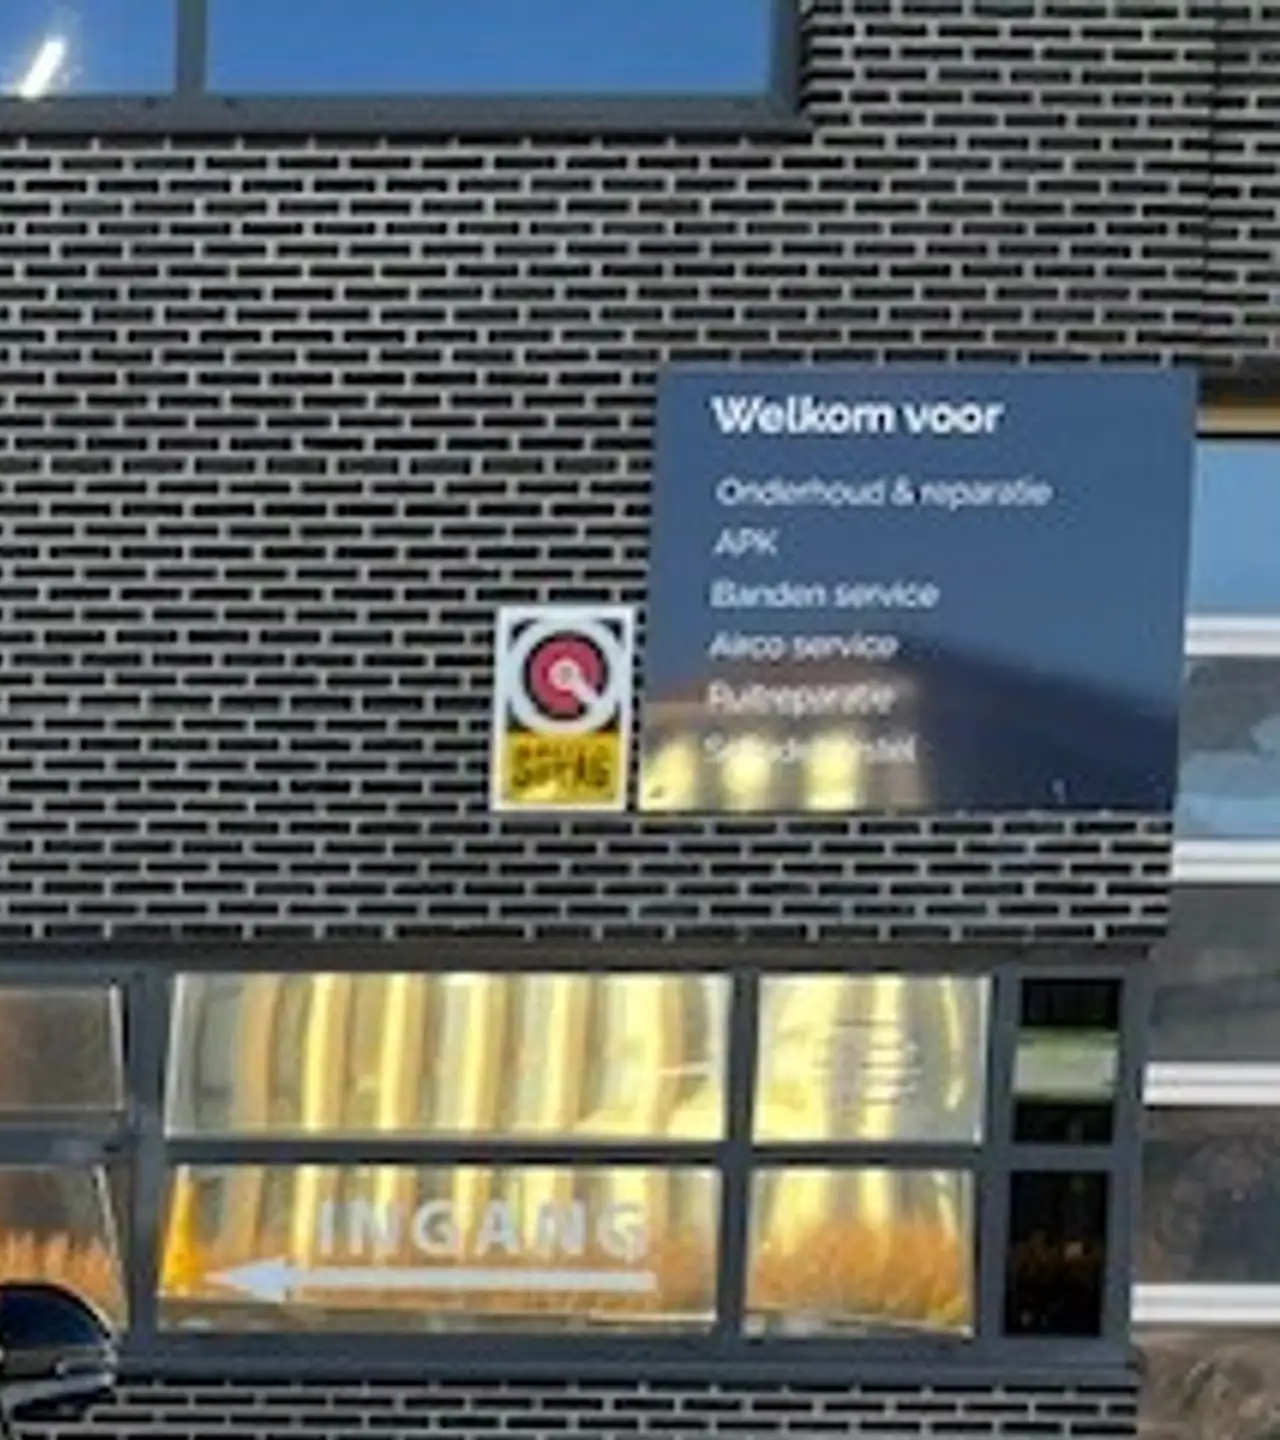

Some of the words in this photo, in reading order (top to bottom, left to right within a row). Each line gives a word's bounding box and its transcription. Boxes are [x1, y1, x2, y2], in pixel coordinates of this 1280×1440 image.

[710, 396, 894, 434] Welkom
[904, 402, 1004, 434] voor
[715, 476, 886, 506] Onderhoud
[890, 475, 913, 507] &
[919, 474, 1053, 512] reparatie
[712, 527, 779, 556] APK
[709, 577, 827, 608] Banden
[834, 577, 940, 608] service
[791, 629, 899, 660] service
[318, 1196, 651, 1263] INGANG
